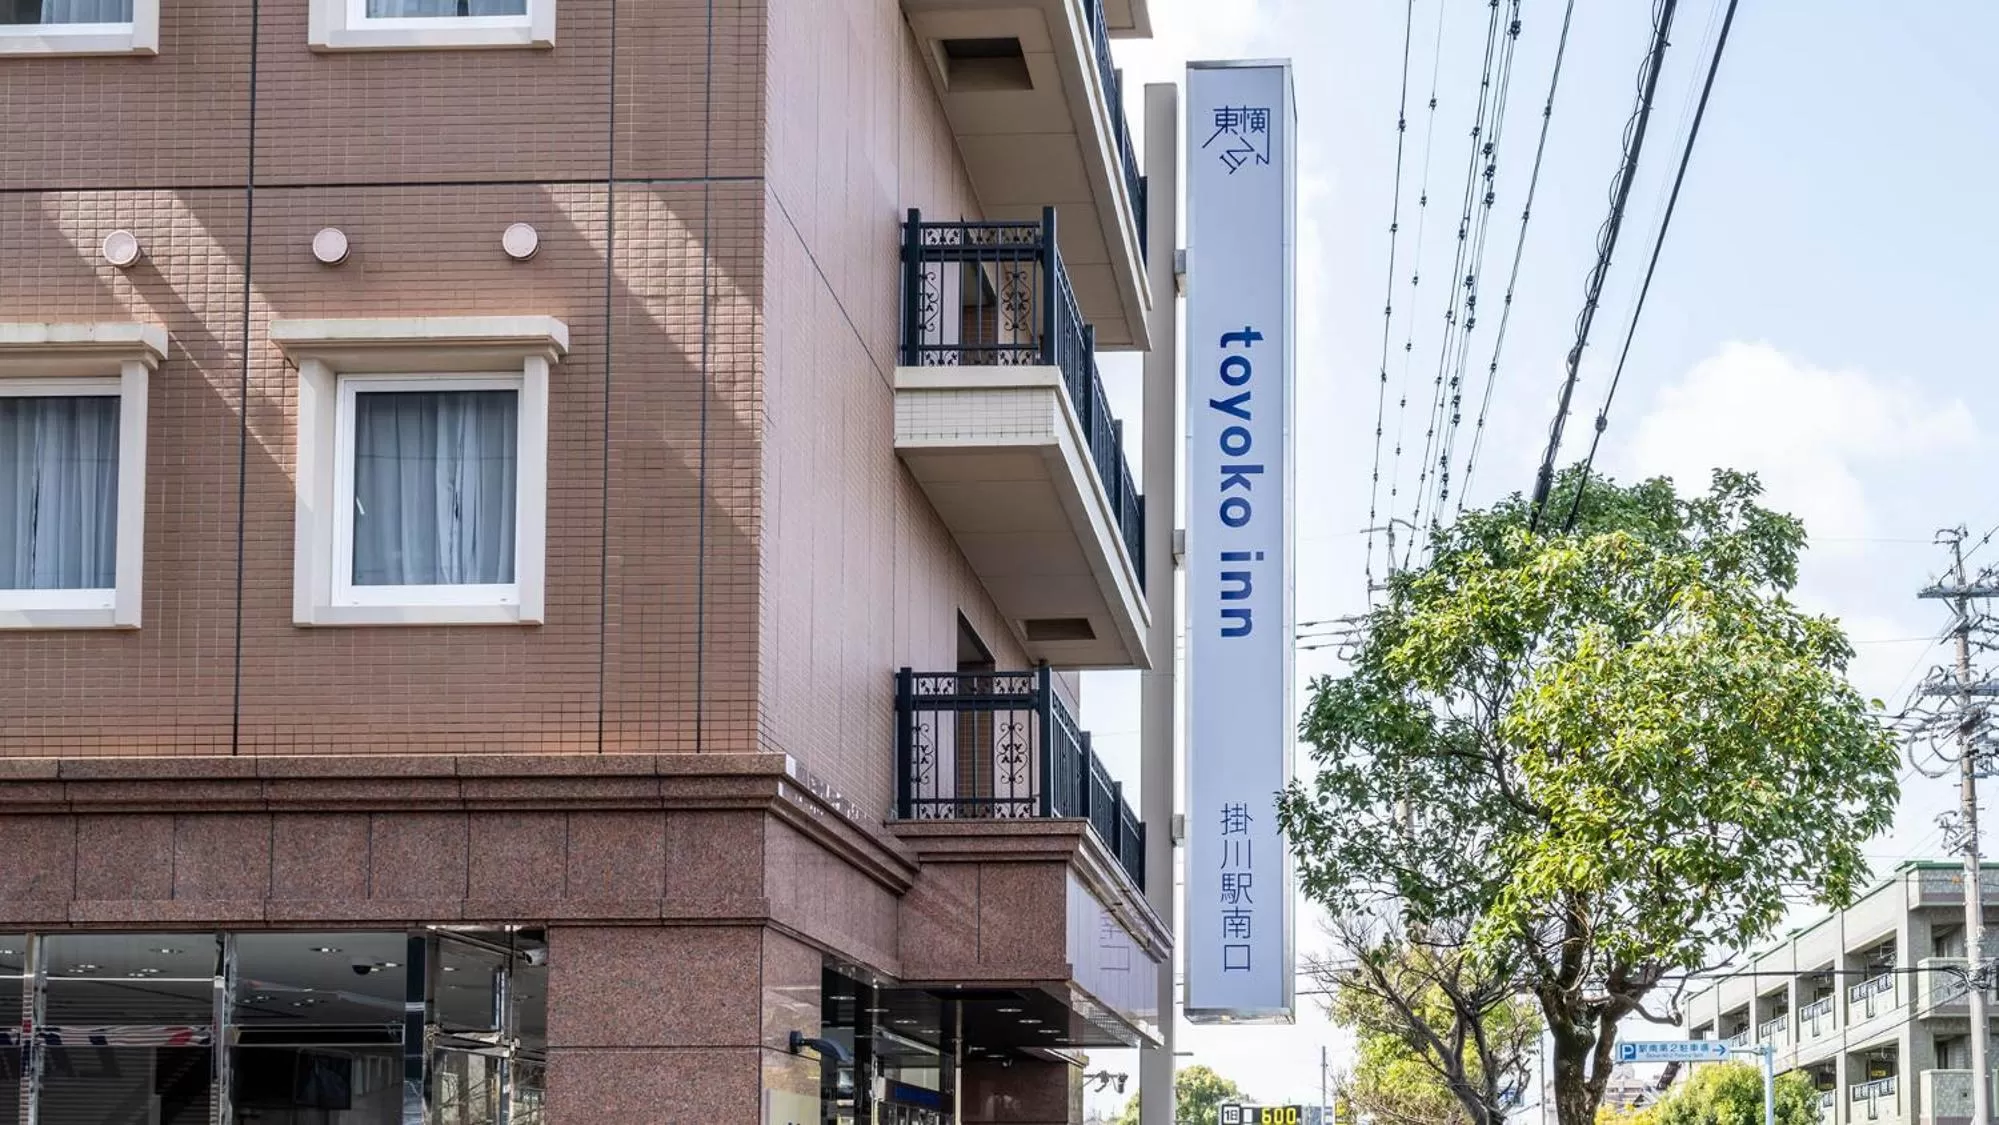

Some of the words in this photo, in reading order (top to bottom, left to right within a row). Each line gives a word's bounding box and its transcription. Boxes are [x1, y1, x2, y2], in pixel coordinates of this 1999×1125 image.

[1209, 326, 1264, 528] toyoko
[1220, 551, 1264, 638] inn
[1220, 803, 1254, 972] 掛川駅南口
[1261, 1107, 1297, 1125] 600
